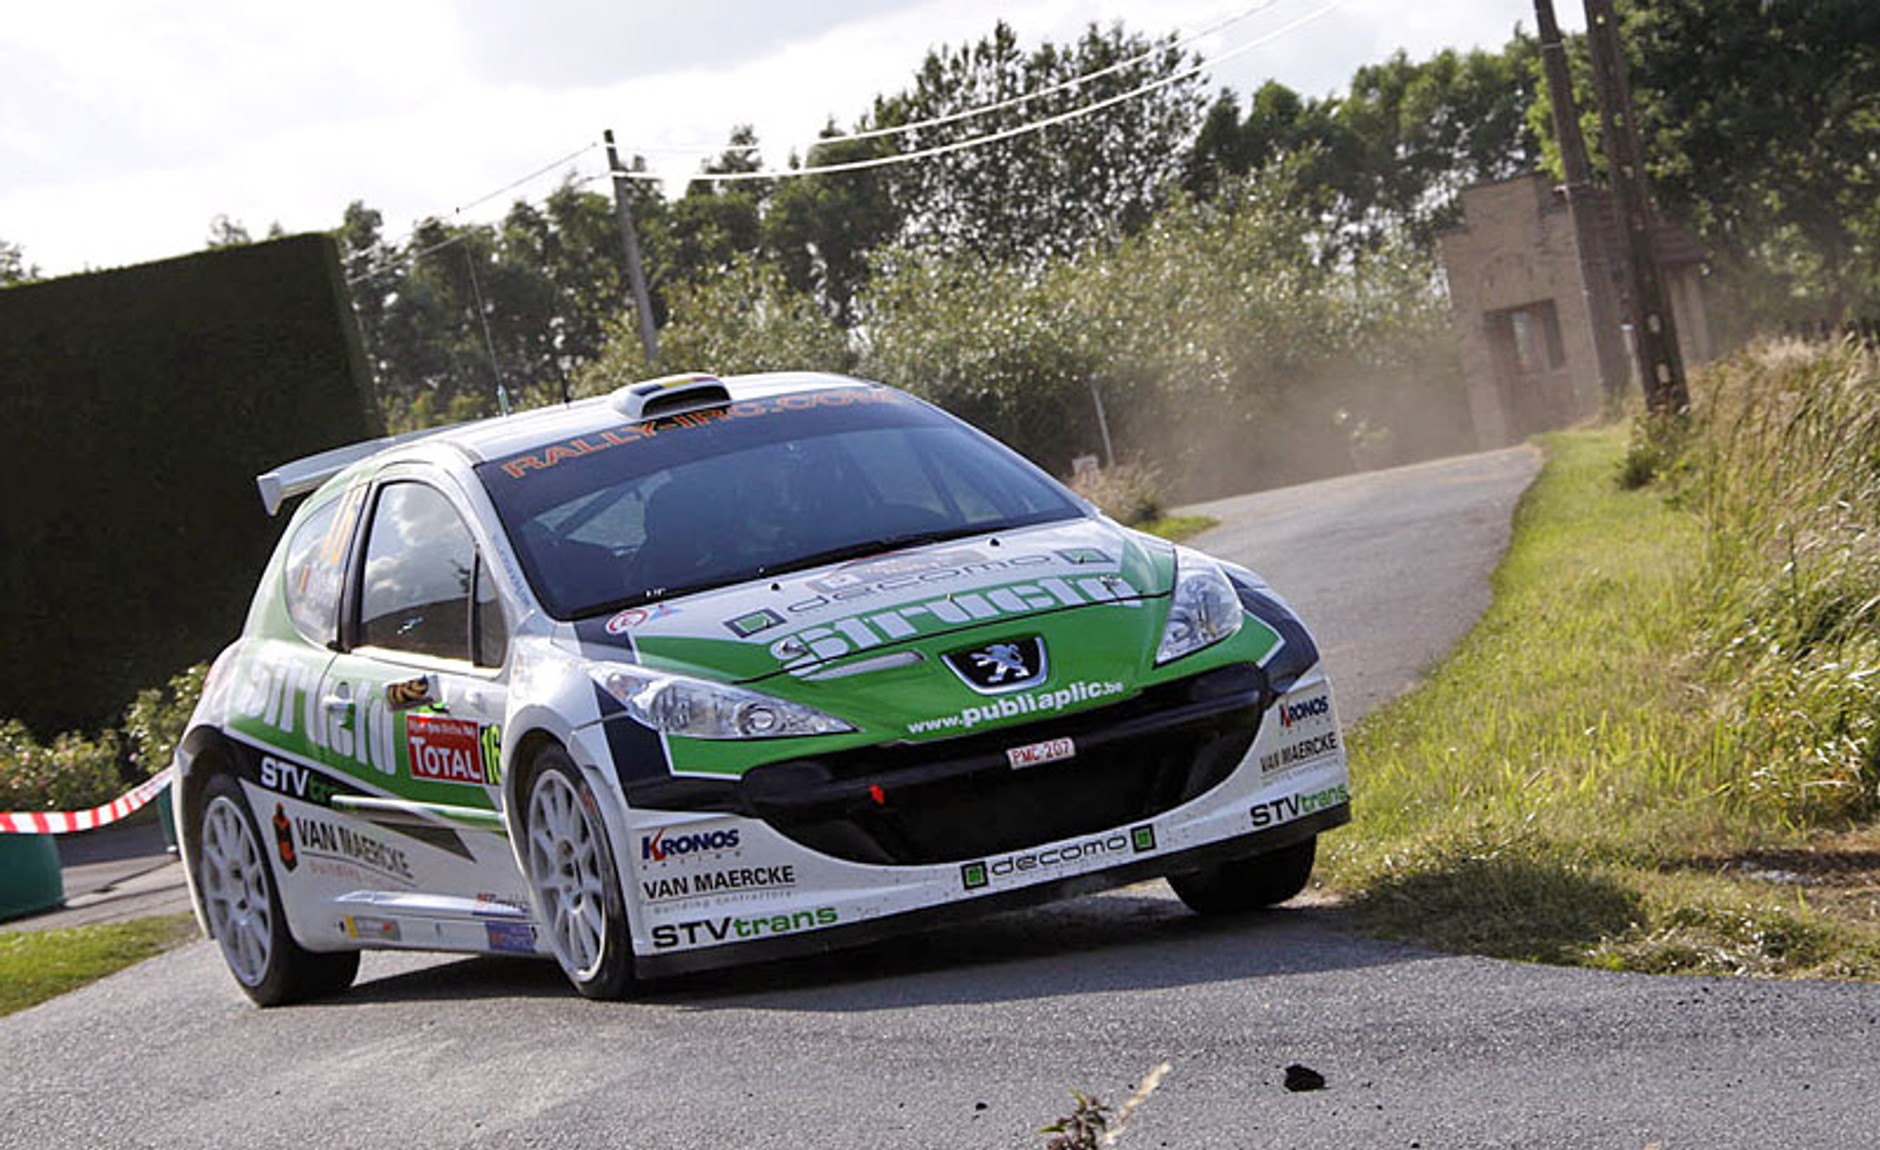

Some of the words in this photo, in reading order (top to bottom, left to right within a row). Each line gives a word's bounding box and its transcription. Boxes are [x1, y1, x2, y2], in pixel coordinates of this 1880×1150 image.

[787, 554, 1051, 613] decomo
[907, 680, 1124, 734] www.publiaplic.be
[482, 723, 502, 784] 16
[1250, 783, 1348, 827] STVtrans
[296, 816, 338, 851] VAN
[641, 827, 740, 861] KRONOS
[991, 835, 1128, 876] decomo
[643, 877, 688, 900] VAN
[694, 865, 796, 892] MAERCKE
[652, 906, 839, 949] STVtrans
